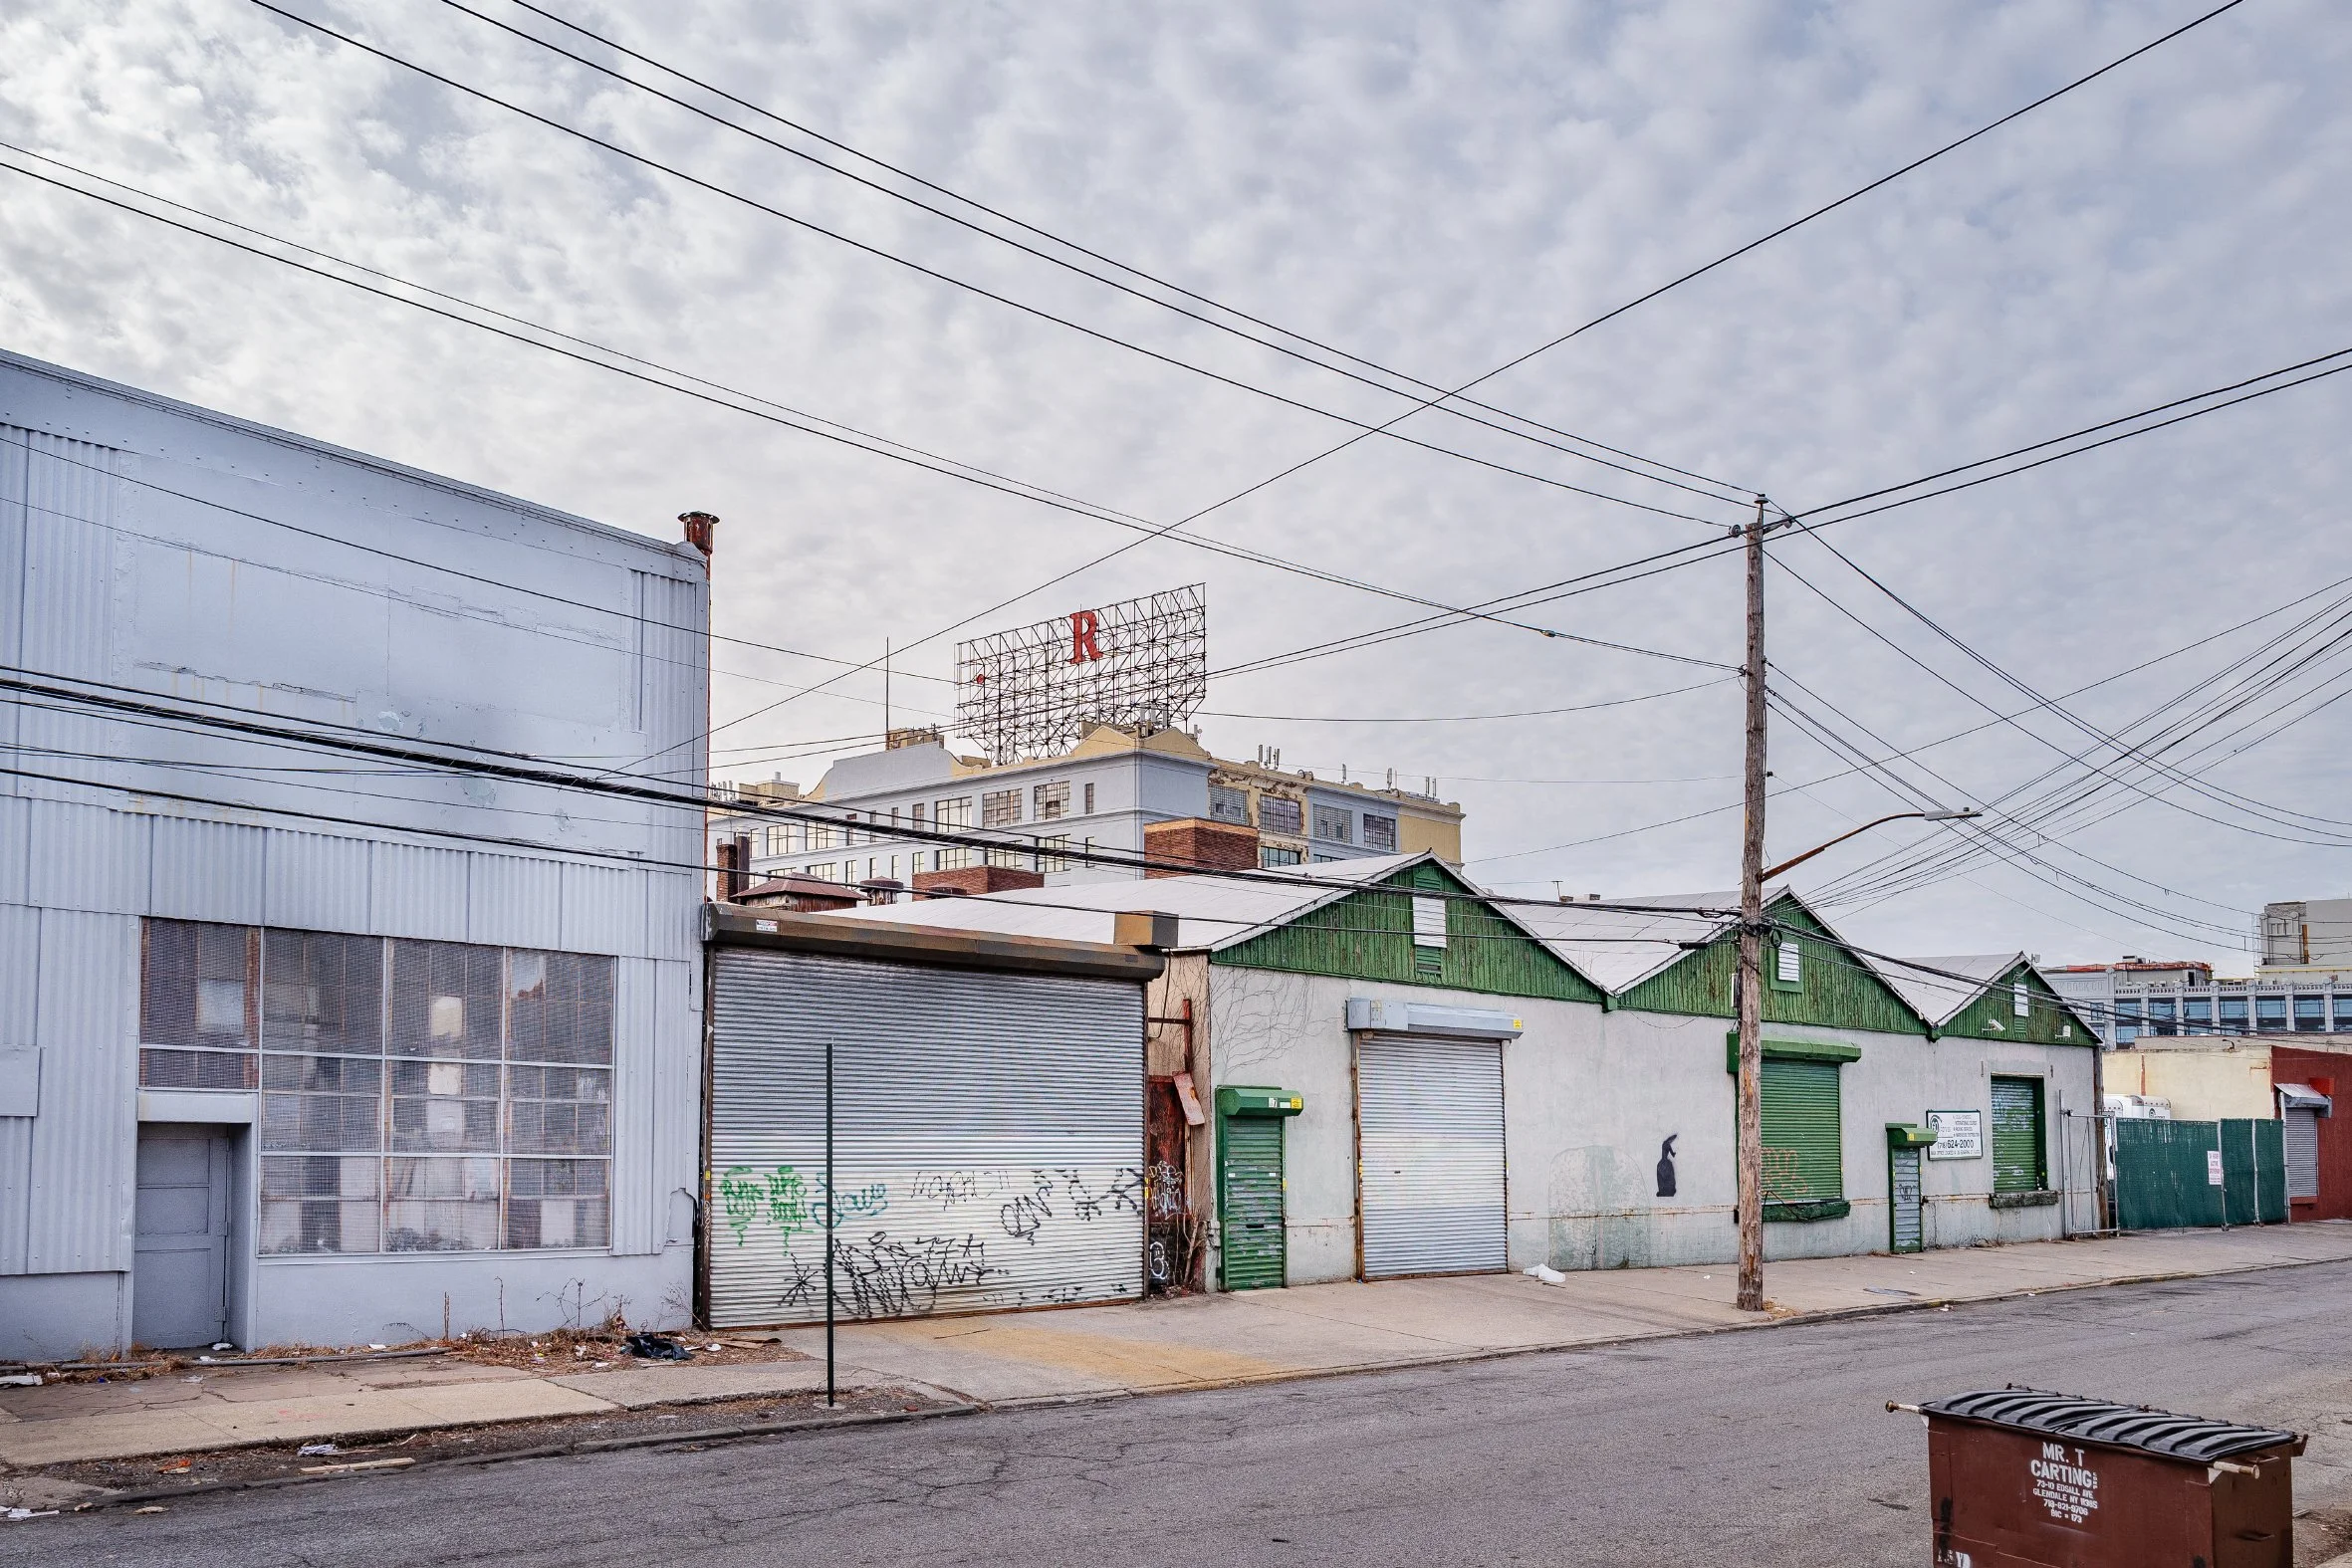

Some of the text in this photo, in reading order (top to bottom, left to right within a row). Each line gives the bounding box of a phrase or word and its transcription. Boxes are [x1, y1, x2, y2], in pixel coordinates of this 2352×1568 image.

[1069, 610, 1103, 664] R
[2042, 1442, 2085, 1466] MR. T
[2030, 1458, 2092, 1488] CARTING
[2032, 1487, 2068, 1502] GLENDALE
[2069, 1495, 2079, 1504] NY
[2036, 1479, 2055, 1489] 73-10
[2056, 1483, 2081, 1496] EDSALL
[2050, 1508, 2063, 1518] BIC
